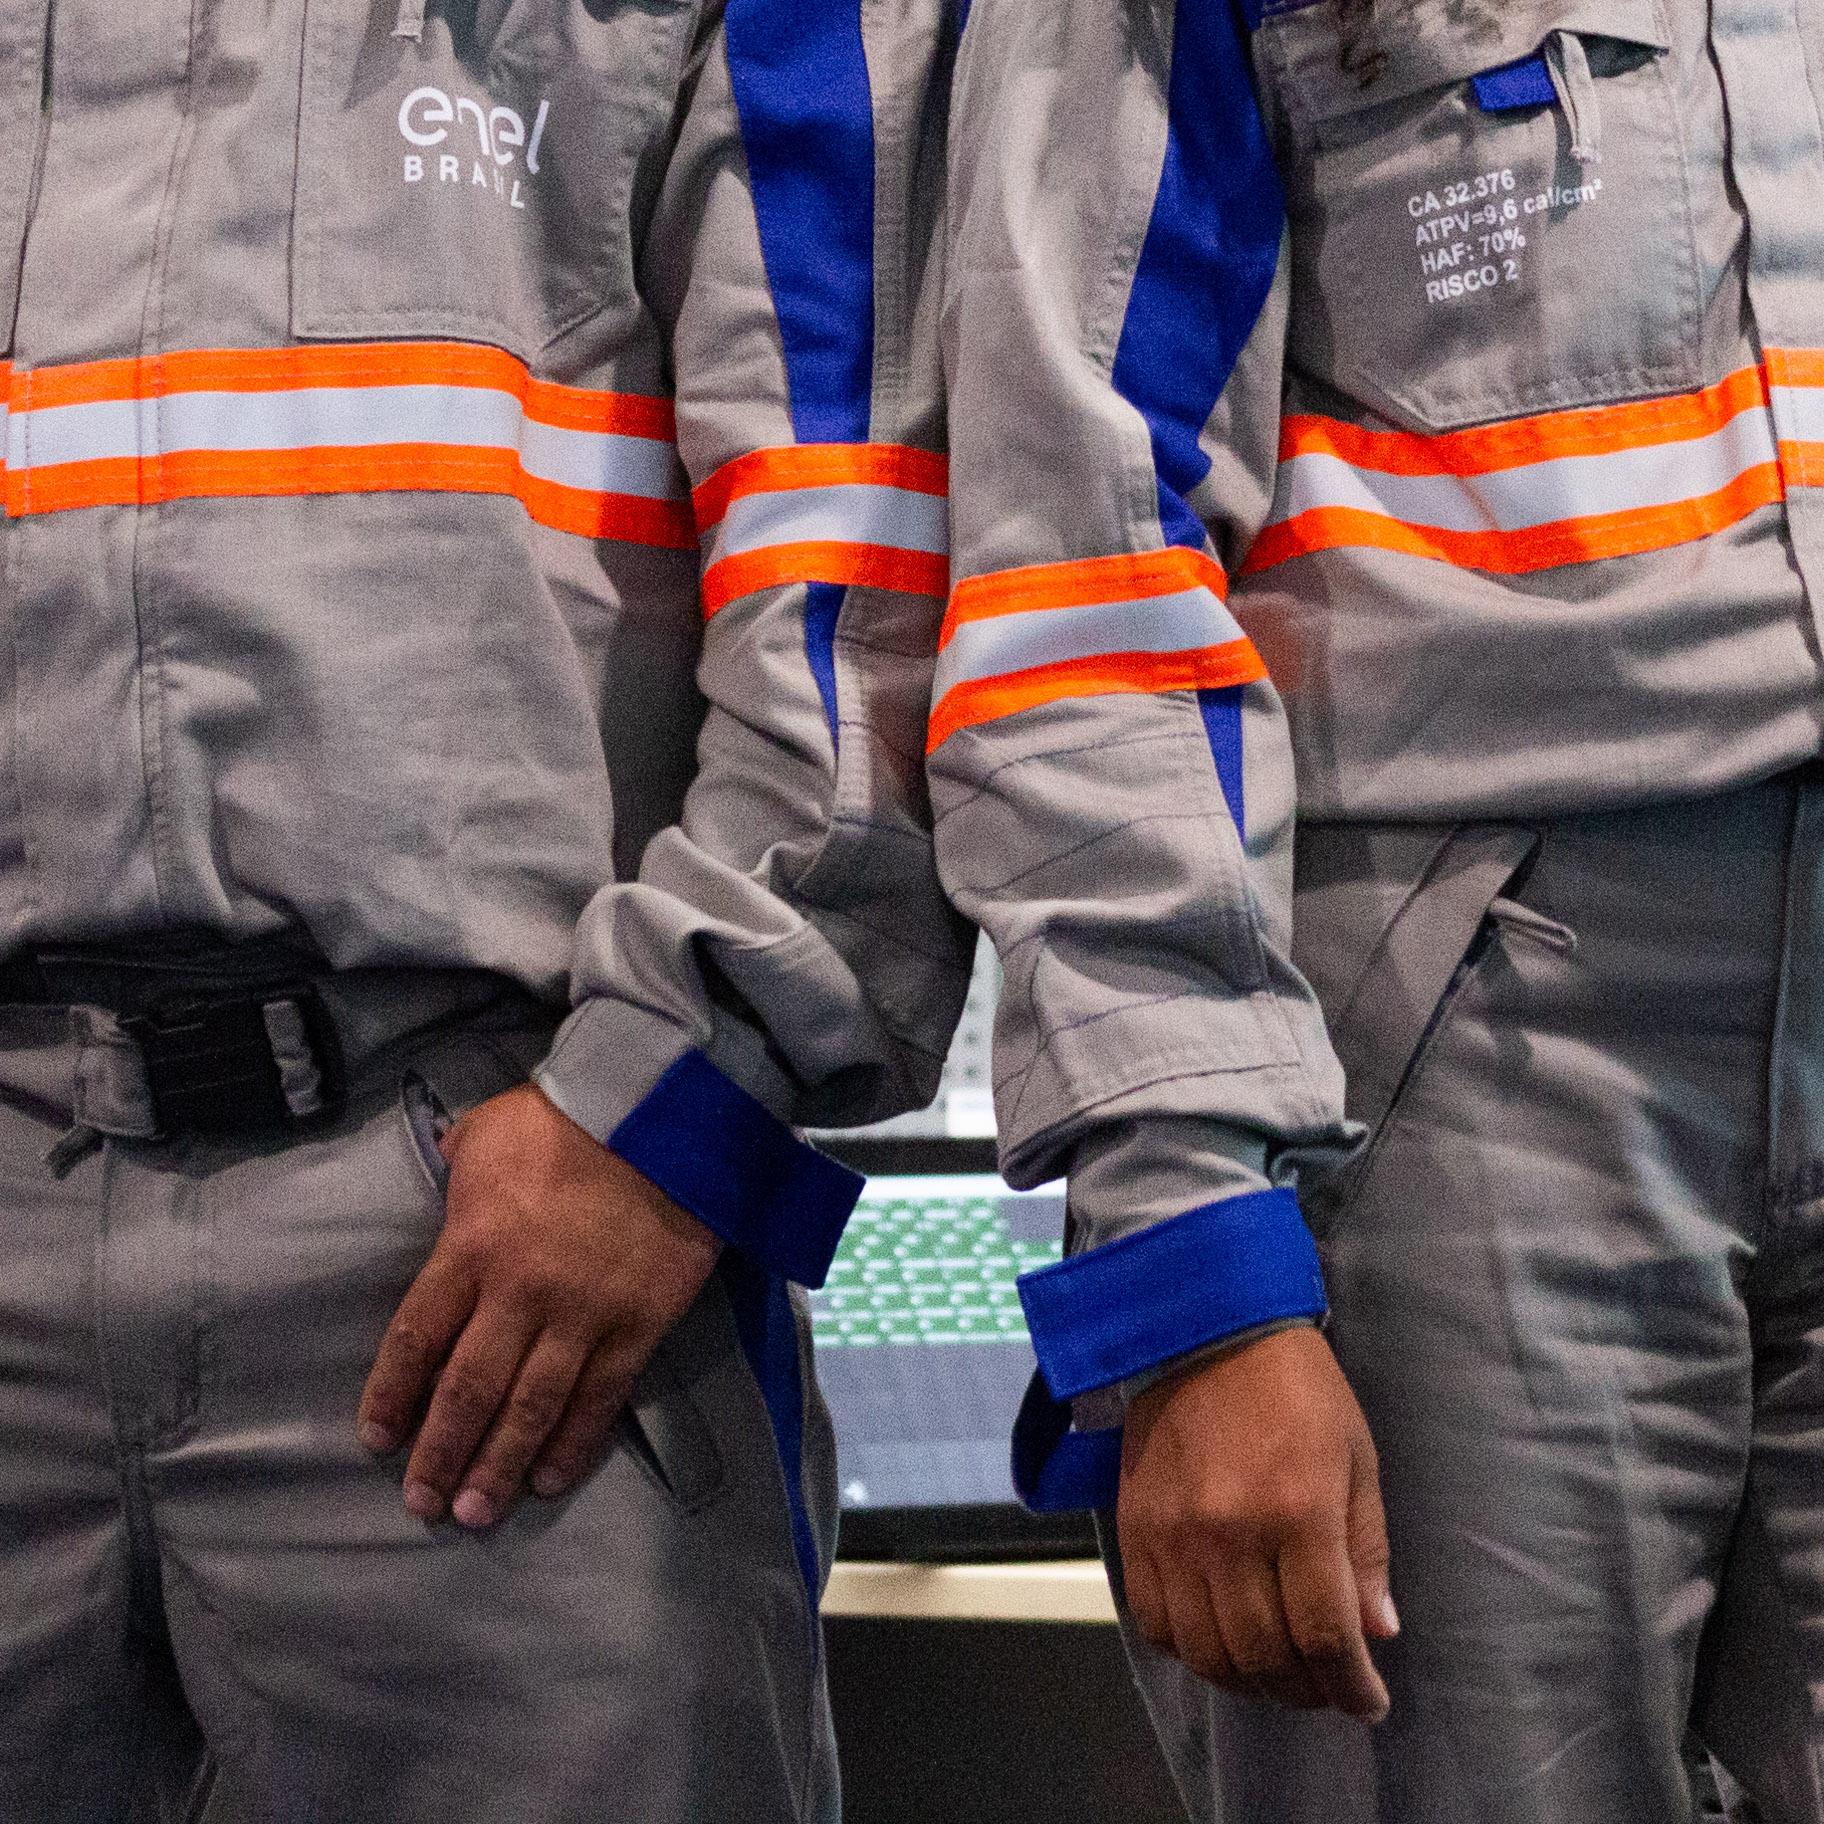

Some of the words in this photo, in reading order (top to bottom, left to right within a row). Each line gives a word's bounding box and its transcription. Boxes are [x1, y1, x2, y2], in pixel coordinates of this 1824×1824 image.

[398, 86, 551, 175] enel
[1407, 189, 1441, 218] CA
[1443, 168, 1516, 208] 32.376
[1415, 197, 1518, 247] ATPV=9,6
[1523, 177, 1604, 215] cal/cm²
[1420, 241, 1475, 275] HAF:
[1479, 226, 1526, 257] 70%
[1425, 264, 1499, 303] RISCO
[1502, 258, 1518, 282] 2
